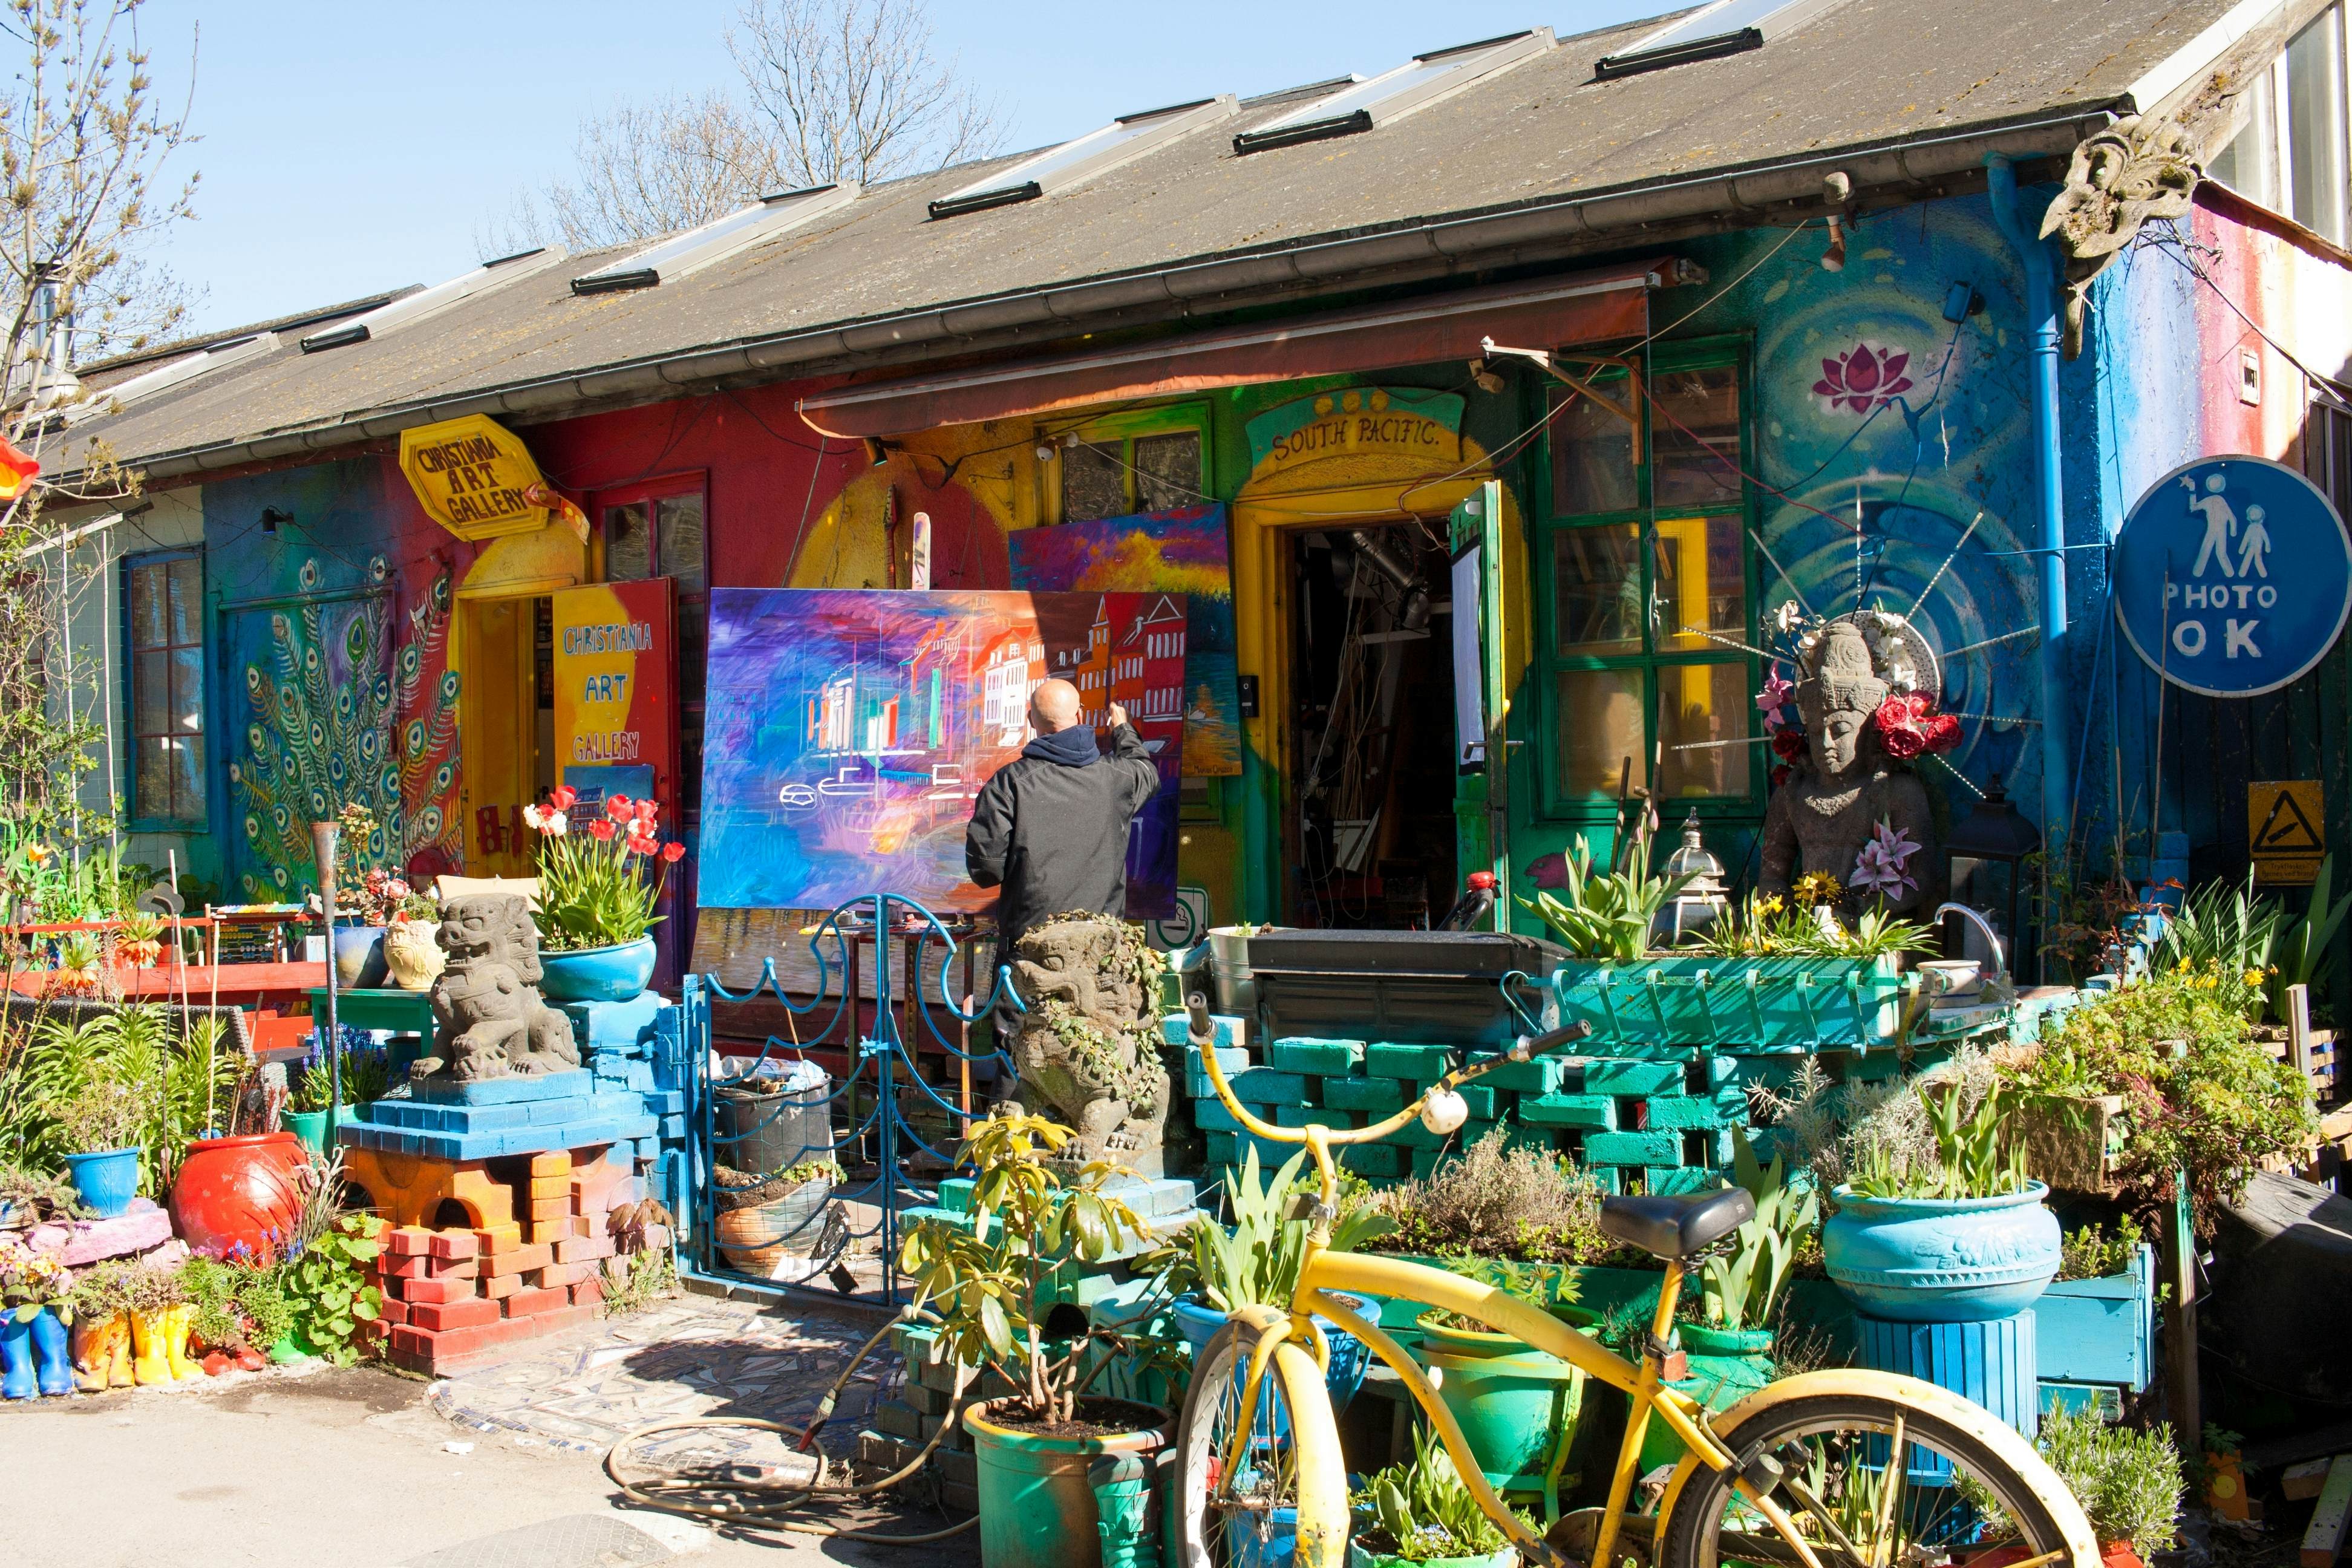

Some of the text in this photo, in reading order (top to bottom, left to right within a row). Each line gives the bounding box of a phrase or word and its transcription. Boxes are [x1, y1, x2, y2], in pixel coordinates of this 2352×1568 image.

[417, 436, 503, 473] CHRISTIANIA
[1272, 420, 1348, 461] SOUTH
[447, 462, 500, 494] ART
[446, 488, 528, 523] GALLERY
[2162, 584, 2278, 609] PHOTO
[2172, 619, 2262, 658] OK
[585, 674, 628, 703] ART
[573, 731, 640, 761] GALLERY
